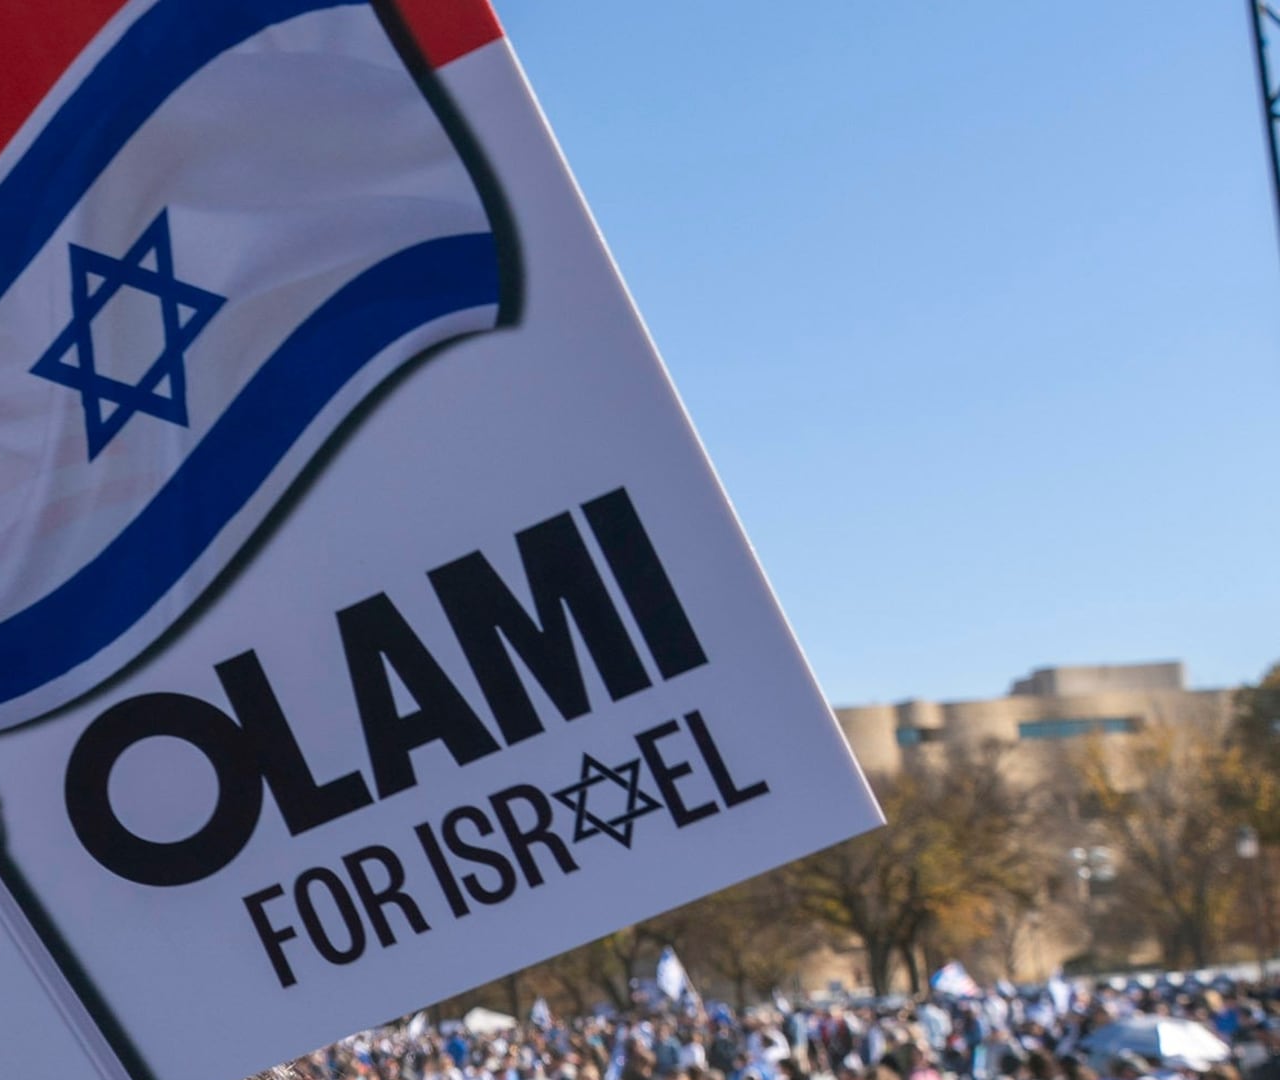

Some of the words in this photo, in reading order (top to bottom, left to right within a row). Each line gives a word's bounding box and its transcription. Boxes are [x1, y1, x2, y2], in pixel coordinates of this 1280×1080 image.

[64, 486, 710, 887] OLAMI
[242, 844, 431, 988] FOR
[414, 709, 769, 919] ISREL
